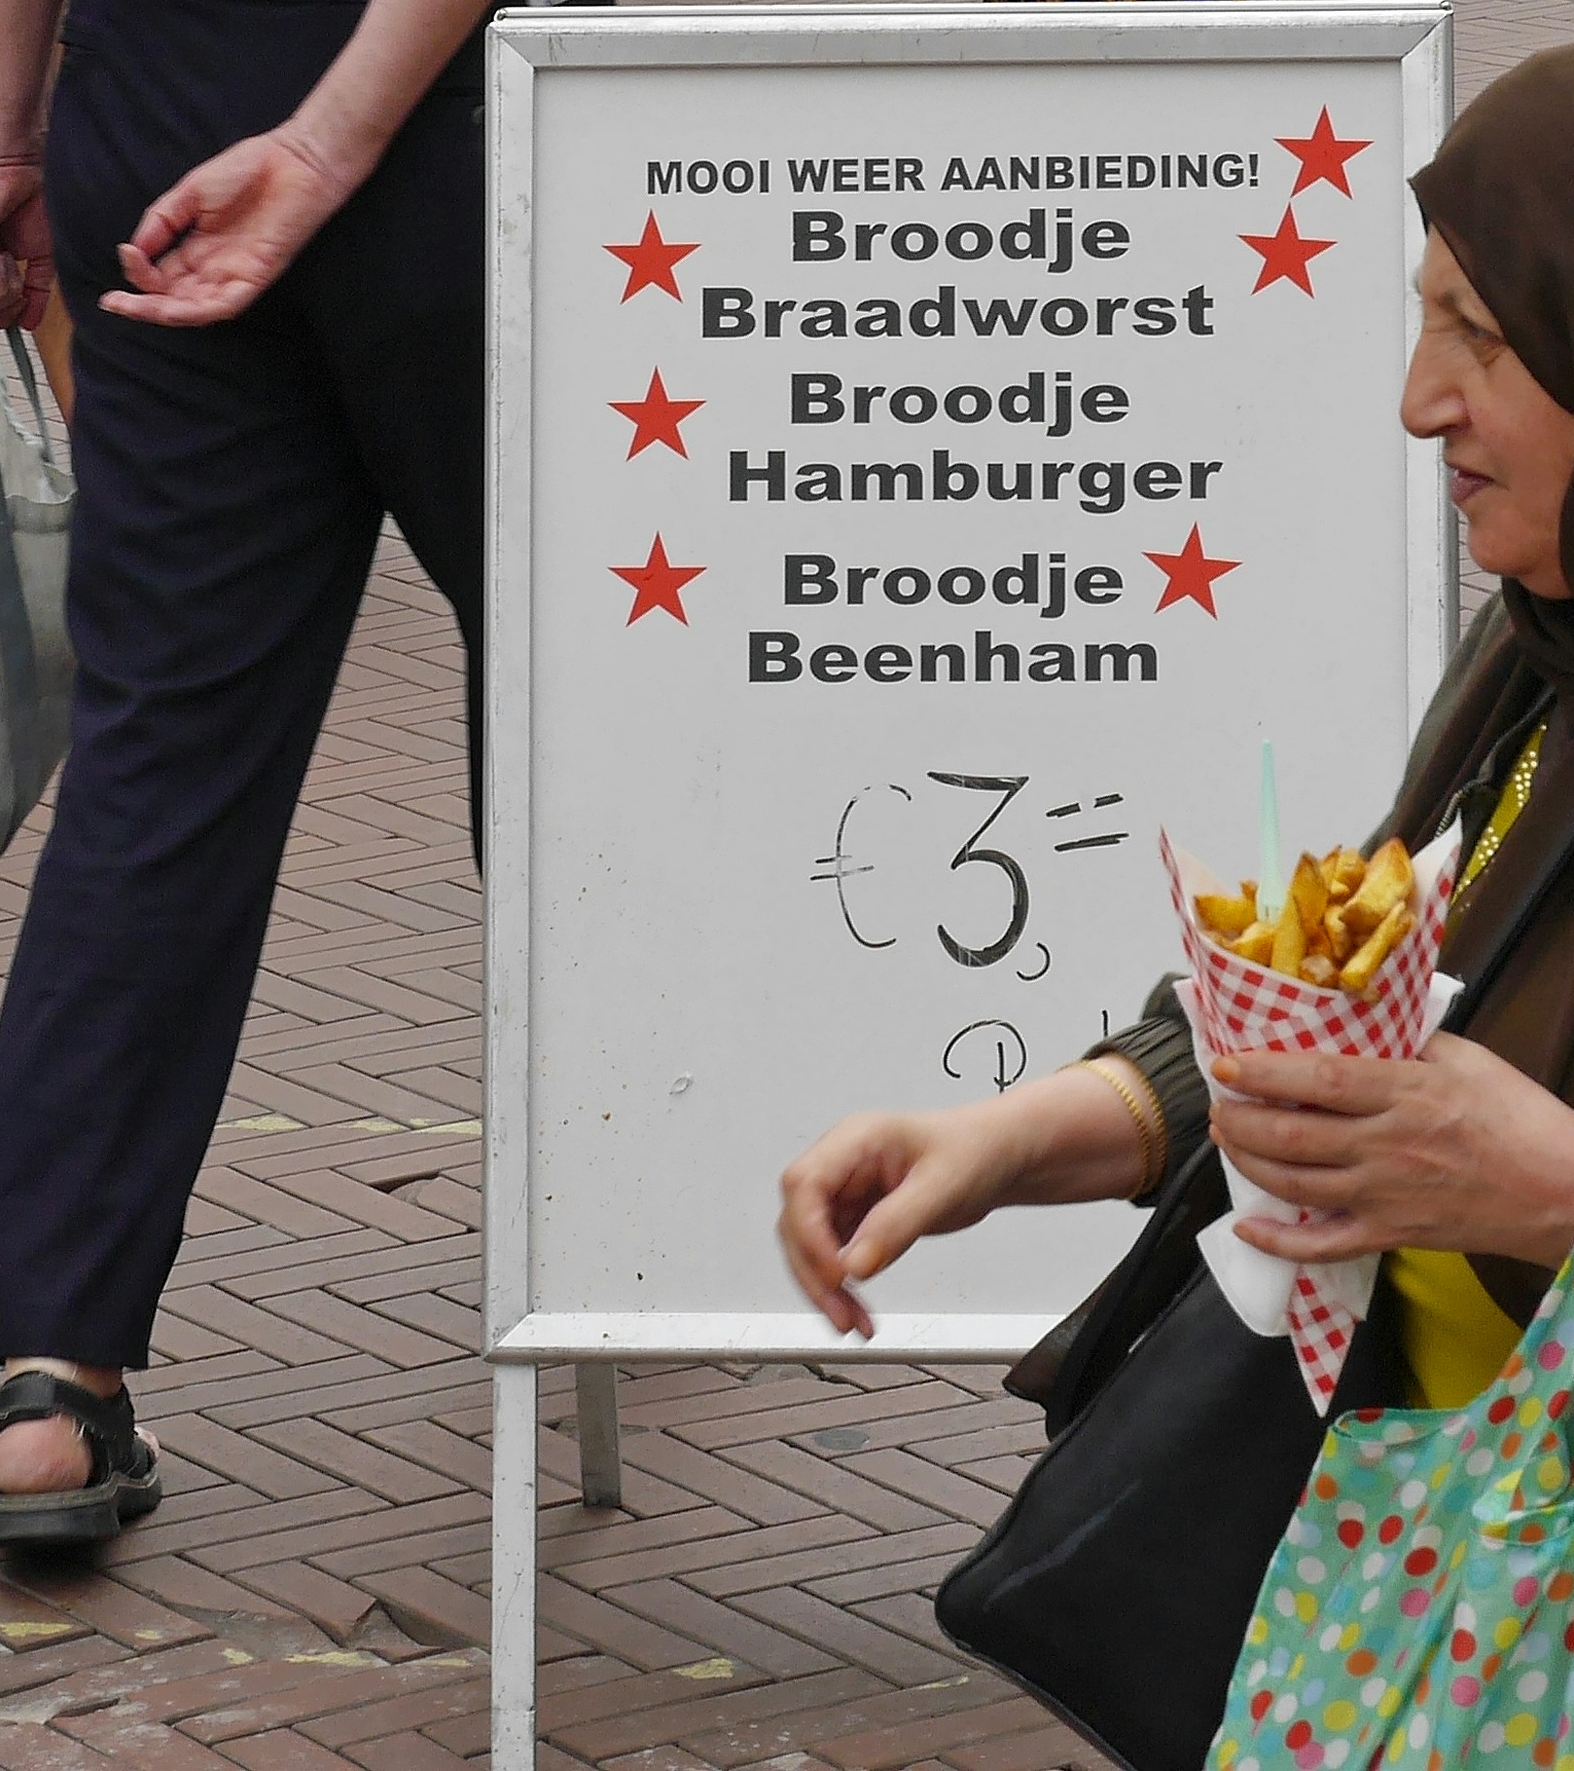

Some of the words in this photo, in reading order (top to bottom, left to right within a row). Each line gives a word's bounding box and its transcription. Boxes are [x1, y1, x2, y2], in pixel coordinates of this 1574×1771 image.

[648, 159, 770, 195] MOOI
[788, 158, 926, 193] WEER
[941, 154, 1259, 191] AANBIEDING!
[792, 208, 1130, 274] Broodje
[702, 284, 1214, 338] Braadworst
[791, 371, 1130, 438] Broodje
[729, 449, 1224, 514] Hamburger
[784, 553, 1124, 619] Broodje
[748, 630, 1158, 683] Beenham
